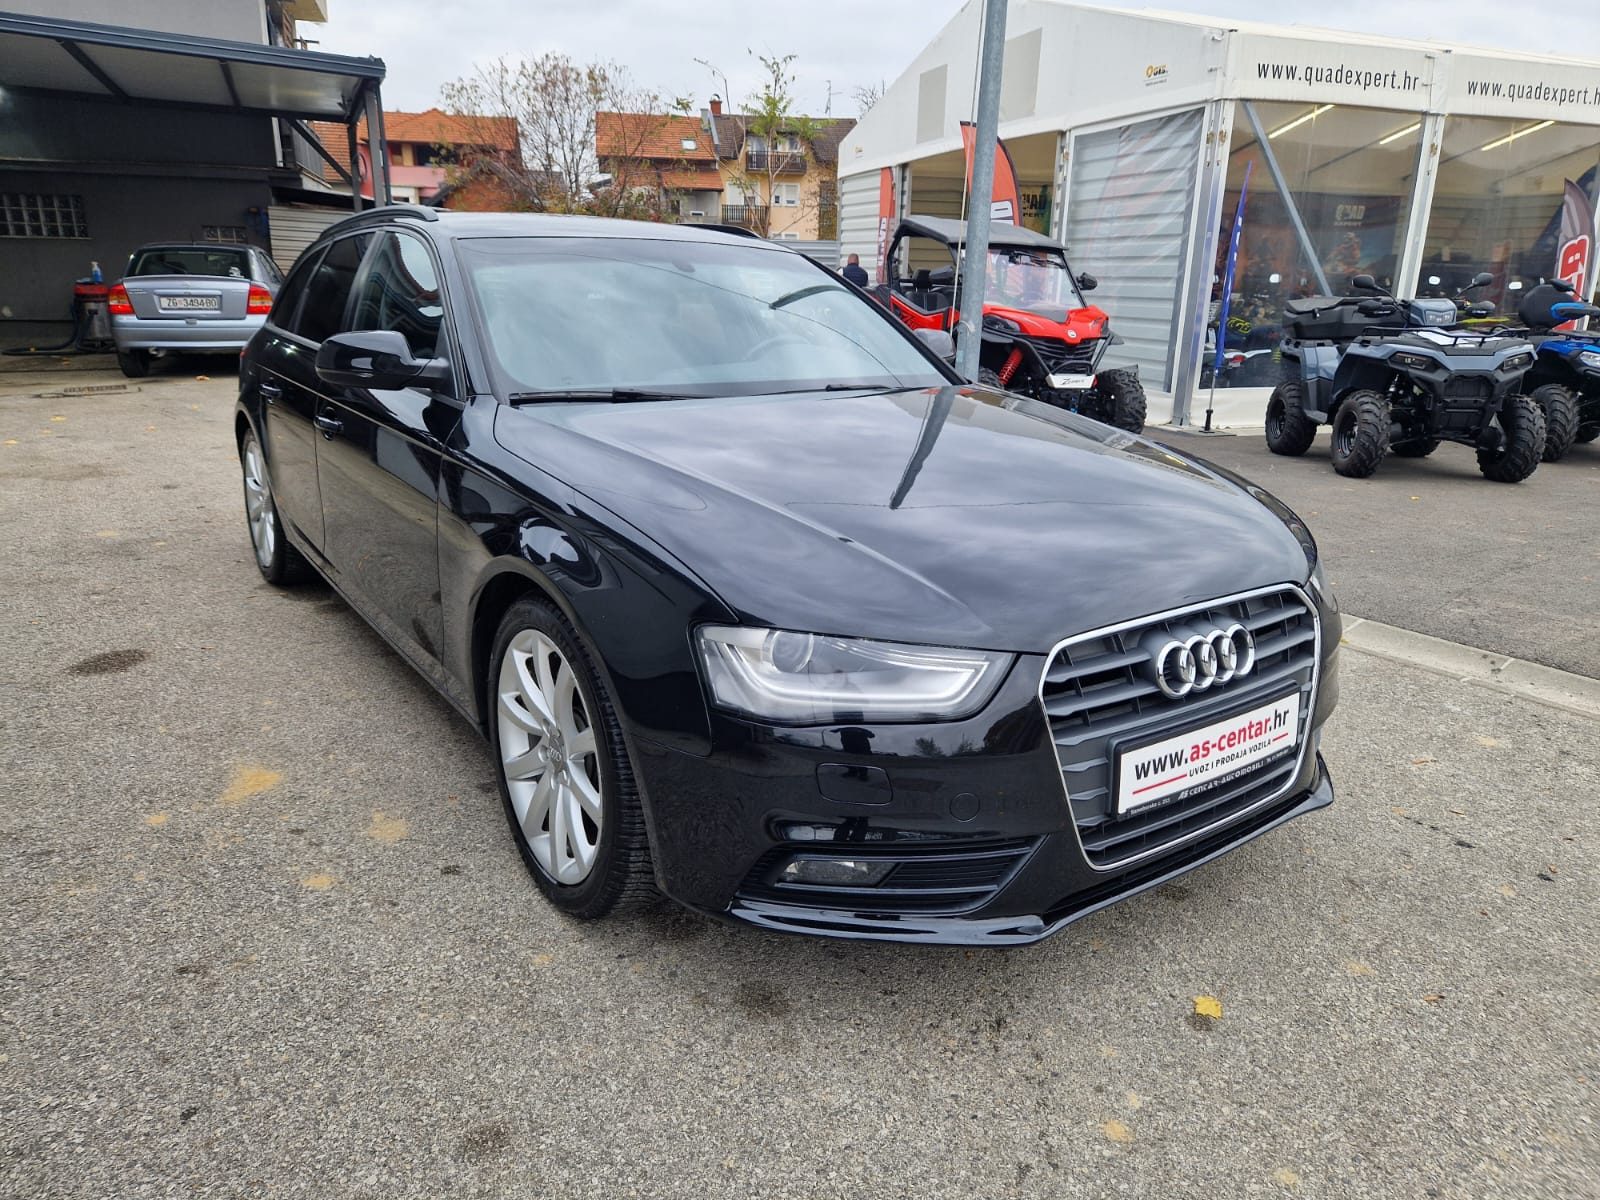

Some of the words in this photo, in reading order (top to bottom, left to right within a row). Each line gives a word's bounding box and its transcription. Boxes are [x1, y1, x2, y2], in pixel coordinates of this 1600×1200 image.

[1257, 62, 1420, 92] www.quadexpert.hr
[167, 297, 178, 307] ZG
[1134, 708, 1290, 781] www.as-centar.hr
[1189, 762, 1210, 778] UVOZ
[1215, 748, 1248, 767] PRODAJA
[1248, 738, 1271, 754] VOZILA
